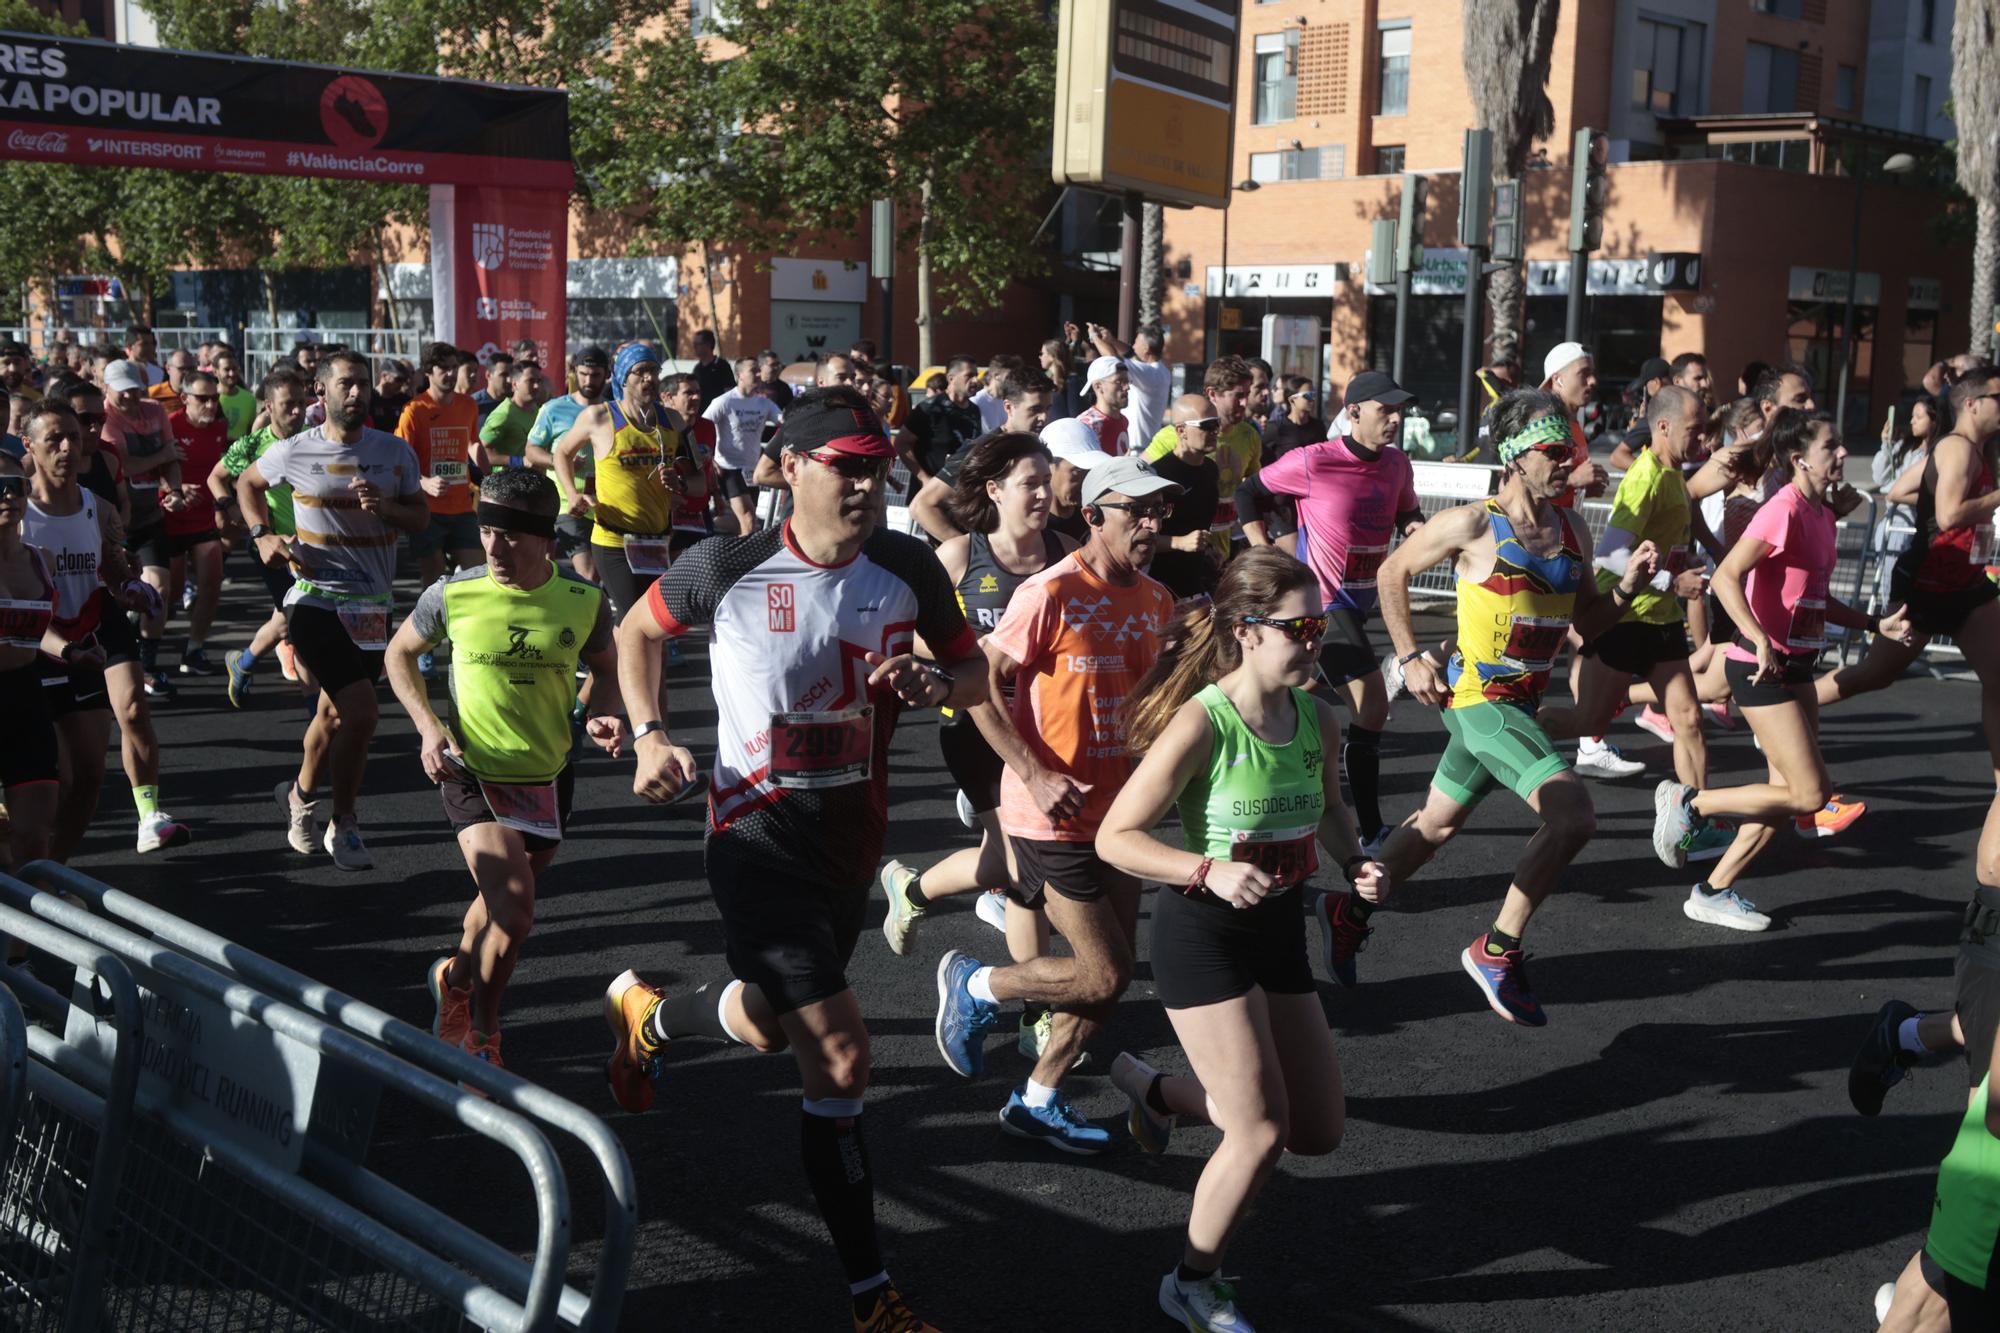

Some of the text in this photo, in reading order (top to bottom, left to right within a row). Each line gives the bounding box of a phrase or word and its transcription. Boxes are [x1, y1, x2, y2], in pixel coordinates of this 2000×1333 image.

[44, 83, 222, 125] POPULAR
[104, 139, 203, 160] INTERSPORT
[287, 152, 425, 175] #ValènciaCorre
[508, 228, 551, 240] Fundació
[501, 299, 531, 310] caixa
[501, 309, 548, 321] popular
[56, 547, 96, 572] clones
[770, 586, 792, 608] SO
[771, 610, 785, 630] M
[1066, 655, 1087, 673] 15
[785, 724, 856, 758] 2997
[214, 1074, 293, 1149] RUNNING
